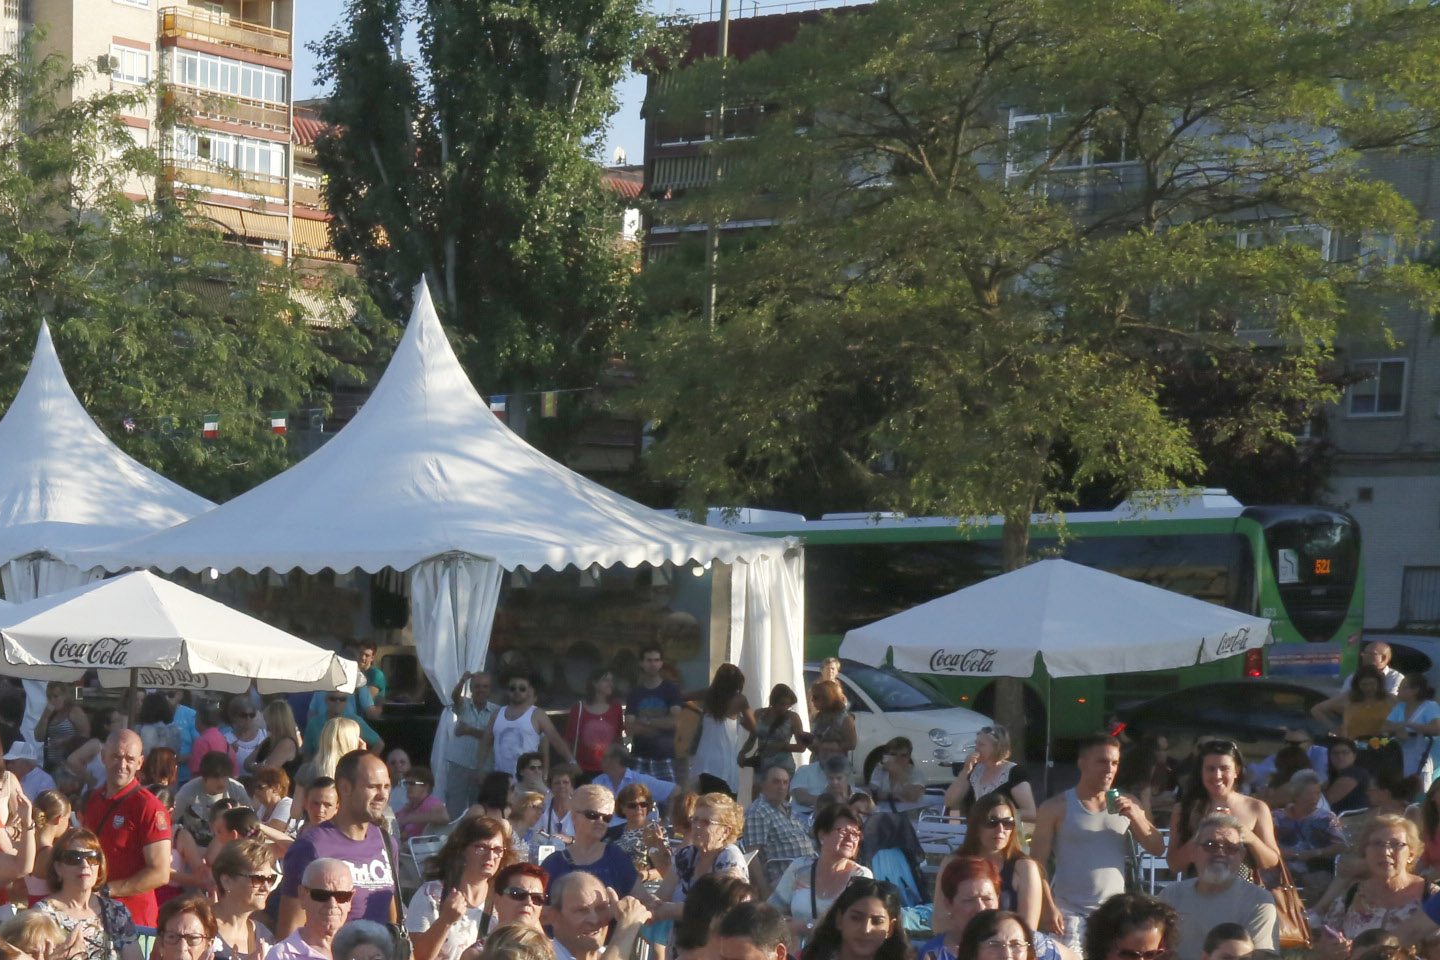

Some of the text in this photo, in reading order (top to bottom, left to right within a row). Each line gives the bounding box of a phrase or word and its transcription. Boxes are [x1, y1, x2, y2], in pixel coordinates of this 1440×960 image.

[1314, 559, 1331, 574] 521
[50, 636, 133, 666] Coca-Cola
[929, 648, 997, 673] Coca-Cola
